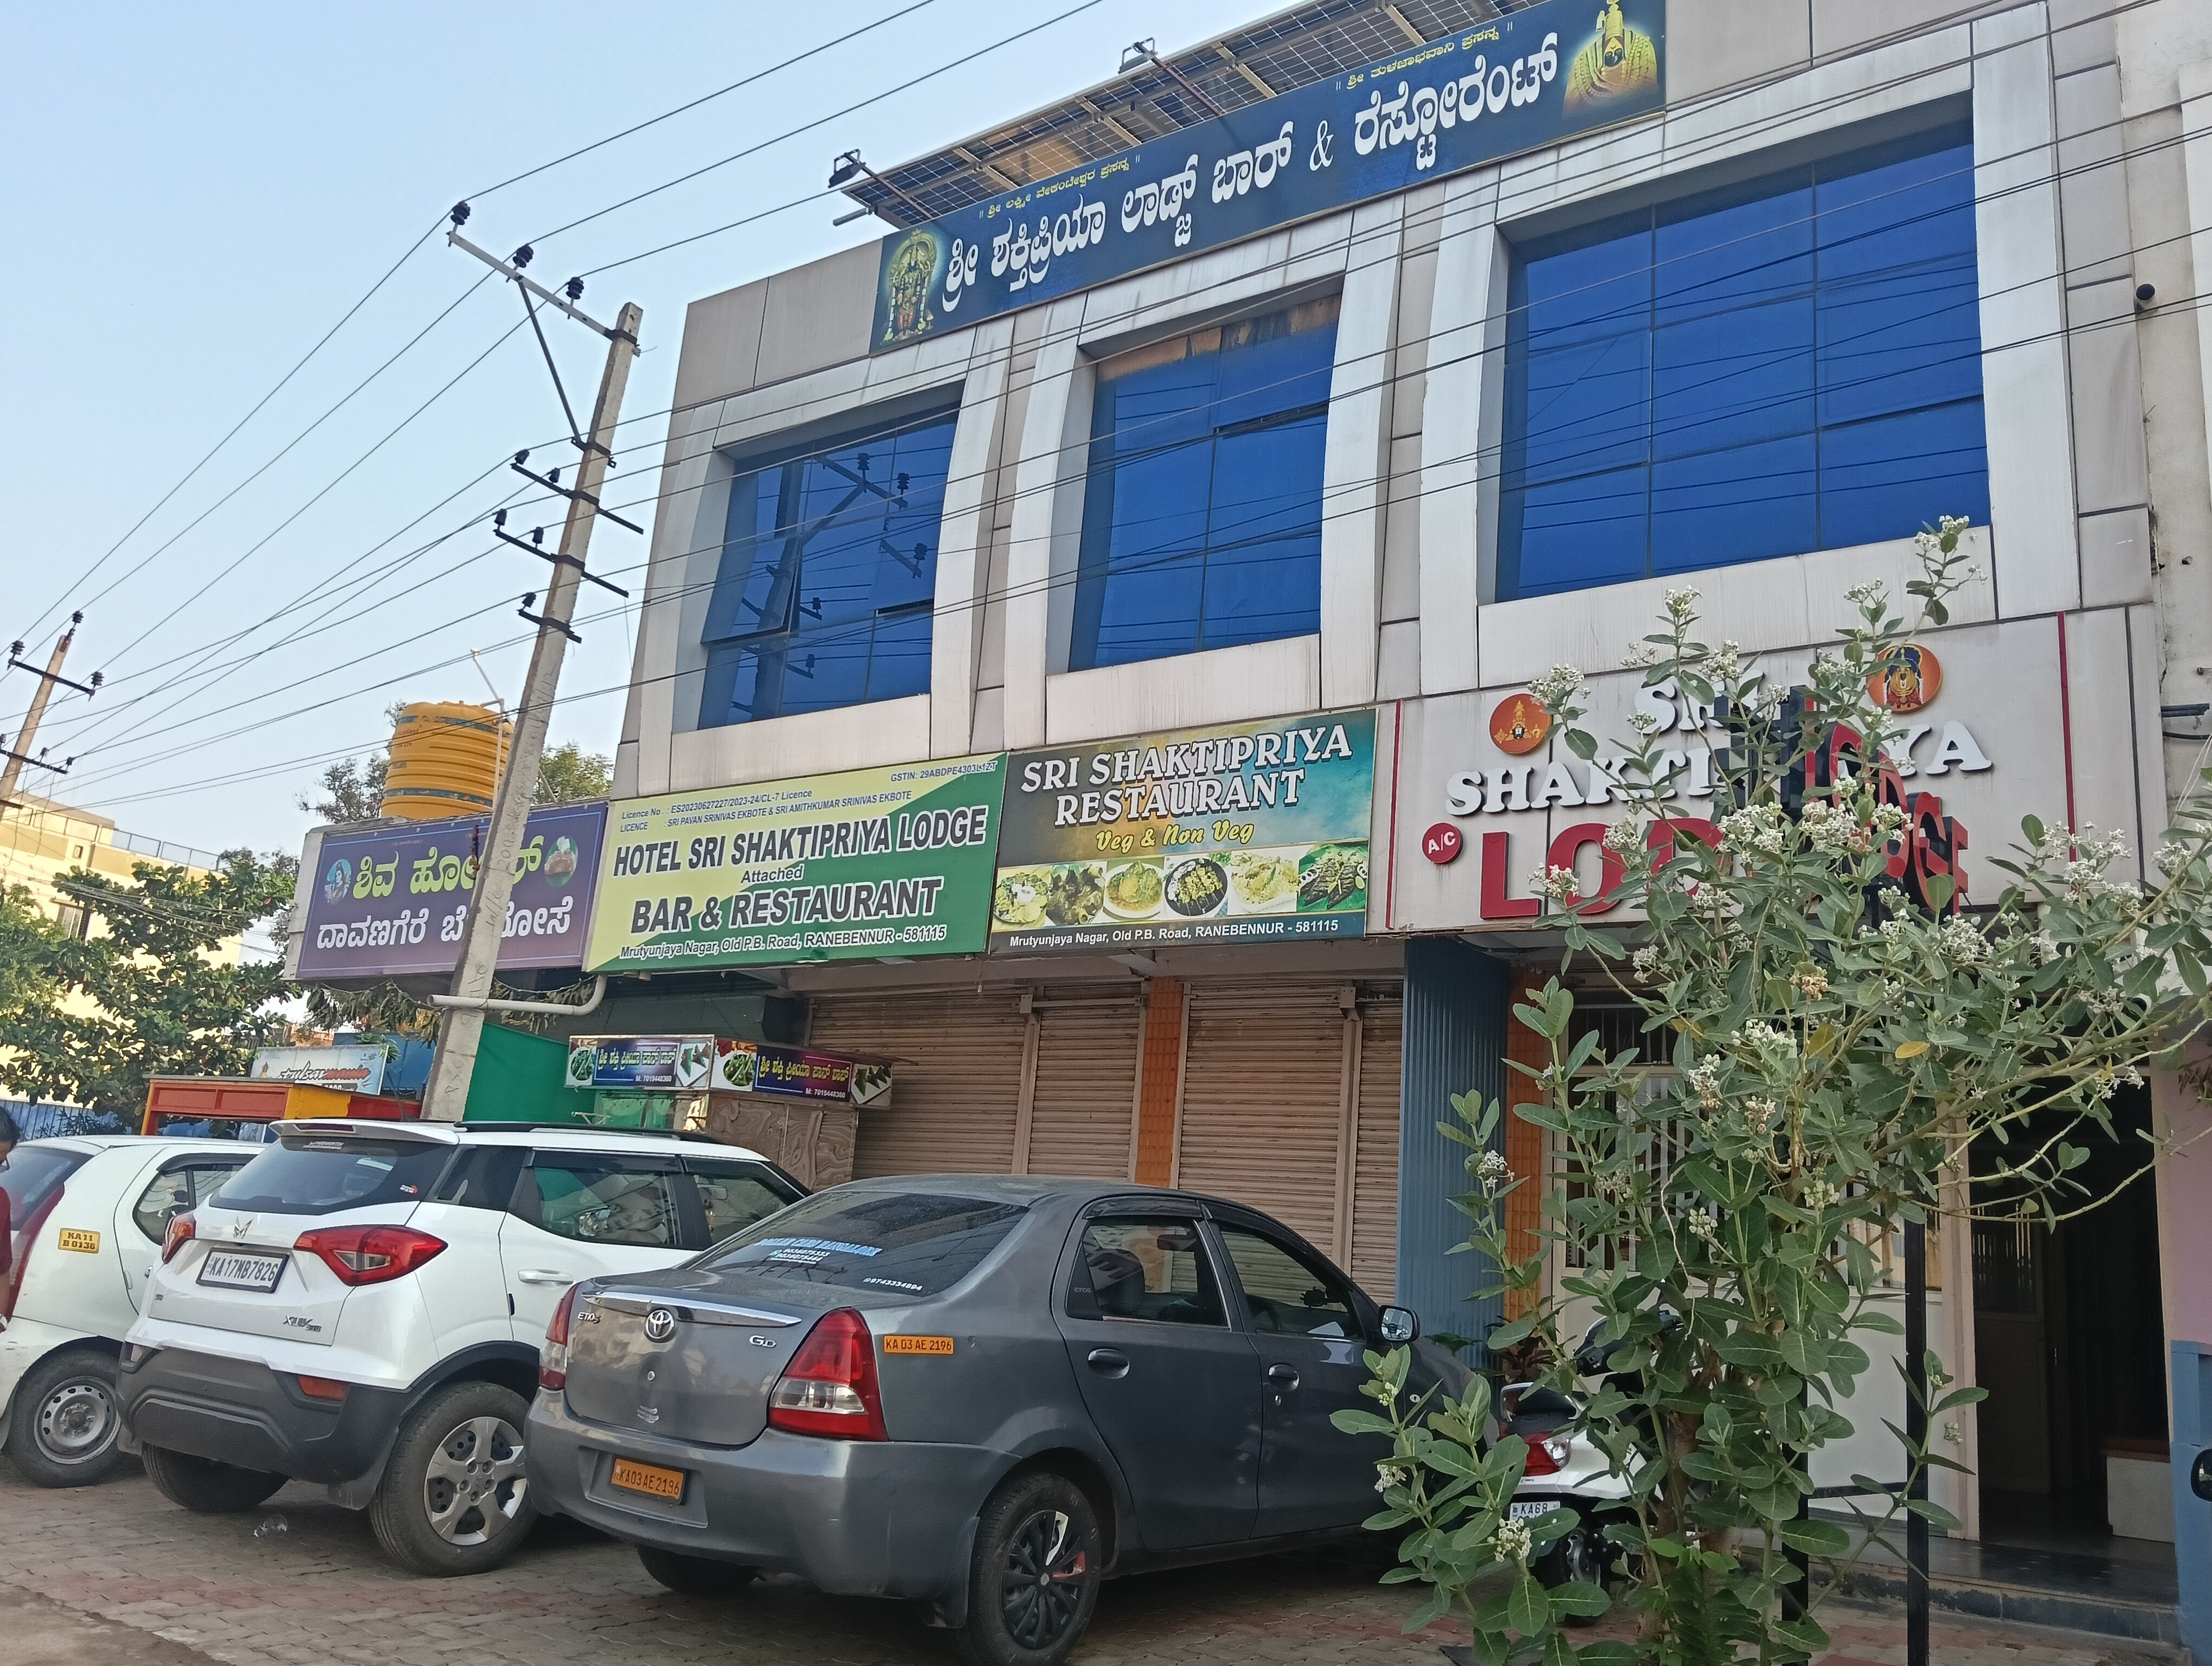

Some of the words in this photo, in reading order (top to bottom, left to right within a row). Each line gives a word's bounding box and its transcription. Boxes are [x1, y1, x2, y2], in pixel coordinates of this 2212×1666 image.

[1346, 73, 1364, 89] ಶ್ರೀ
[1462, 26, 1500, 49] ಪ್ರಸನ್ನ
[942, 238, 979, 312] ಶ್ರೀ
[991, 194, 1105, 292] ಶಕ್ತಿಪ್ರಿಯಾ
[1121, 155, 1199, 247] ಲಾಡ್ಜ್
[1211, 121, 1294, 205] ಬಾರ್
[1309, 119, 1335, 171] &
[1354, 32, 1558, 170] ರೆಸ್ಟೋರೆಂಟ್
[1021, 757, 1080, 794] SRI
[1088, 724, 1353, 788] SHAKTIPRIYA
[891, 772, 918, 782] GSTIN:
[620, 822, 648, 832] LICENCE
[667, 817, 680, 828] SRI
[680, 815, 703, 826] PAVAN
[704, 811, 736, 823] SRINIVAS
[737, 808, 767, 819] EKBOTE
[775, 805, 788, 815] SRI
[788, 799, 840, 813] AMITHKUMAR
[841, 794, 877, 808] SRINIVAS
[879, 790, 912, 803] EKBOTE
[622, 808, 649, 819] Licence
[781, 789, 813, 800] Licence
[1054, 768, 1305, 828] RESTAURANT
[613, 838, 683, 877] HOTEL
[688, 832, 725, 870] SRI
[730, 817, 891, 866] SHAKTIPRIYA
[897, 807, 988, 852] LODGE
[1095, 829, 1134, 854] Veg
[1140, 829, 1156, 848] &
[1163, 824, 1204, 847] Non
[1212, 820, 1255, 844] Veg
[1427, 831, 1456, 855] A/C
[353, 851, 399, 899] ಶಿವ
[741, 865, 803, 884] Attached
[630, 895, 693, 934] BAR
[699, 896, 722, 927] &
[730, 878, 943, 926] RESTAURANT
[317, 907, 429, 949] ದಾವಣಗೆರೆ
[620, 943, 682, 960] Mrutyunjaya
[685, 941, 719, 955] Nagar,
[722, 938, 742, 951] Old
[743, 936, 765, 950] P.B.
[768, 934, 801, 949] Road,
[806, 929, 893, 947] RANEBENNUR
[904, 925, 947, 942] 581115
[1010, 934, 1073, 947] Mrutyunjaya
[1076, 932, 1110, 945] Nagar,
[1113, 930, 1132, 941] Old
[1134, 928, 1156, 940] P.B.
[1159, 927, 1192, 940] Road,
[1195, 922, 1285, 938] RANEBENNUR
[1295, 920, 1339, 933] 581115
[67, 1232, 81, 1240] KA
[209, 1257, 278, 1282] KA17MB7826
[749, 1335, 776, 1348] GD
[886, 1338, 898, 1350] KA
[901, 1338, 913, 1350] 03
[915, 1339, 927, 1350] AE
[929, 1340, 952, 1351] 2196
[1521, 1503, 1548, 1515] KA68
